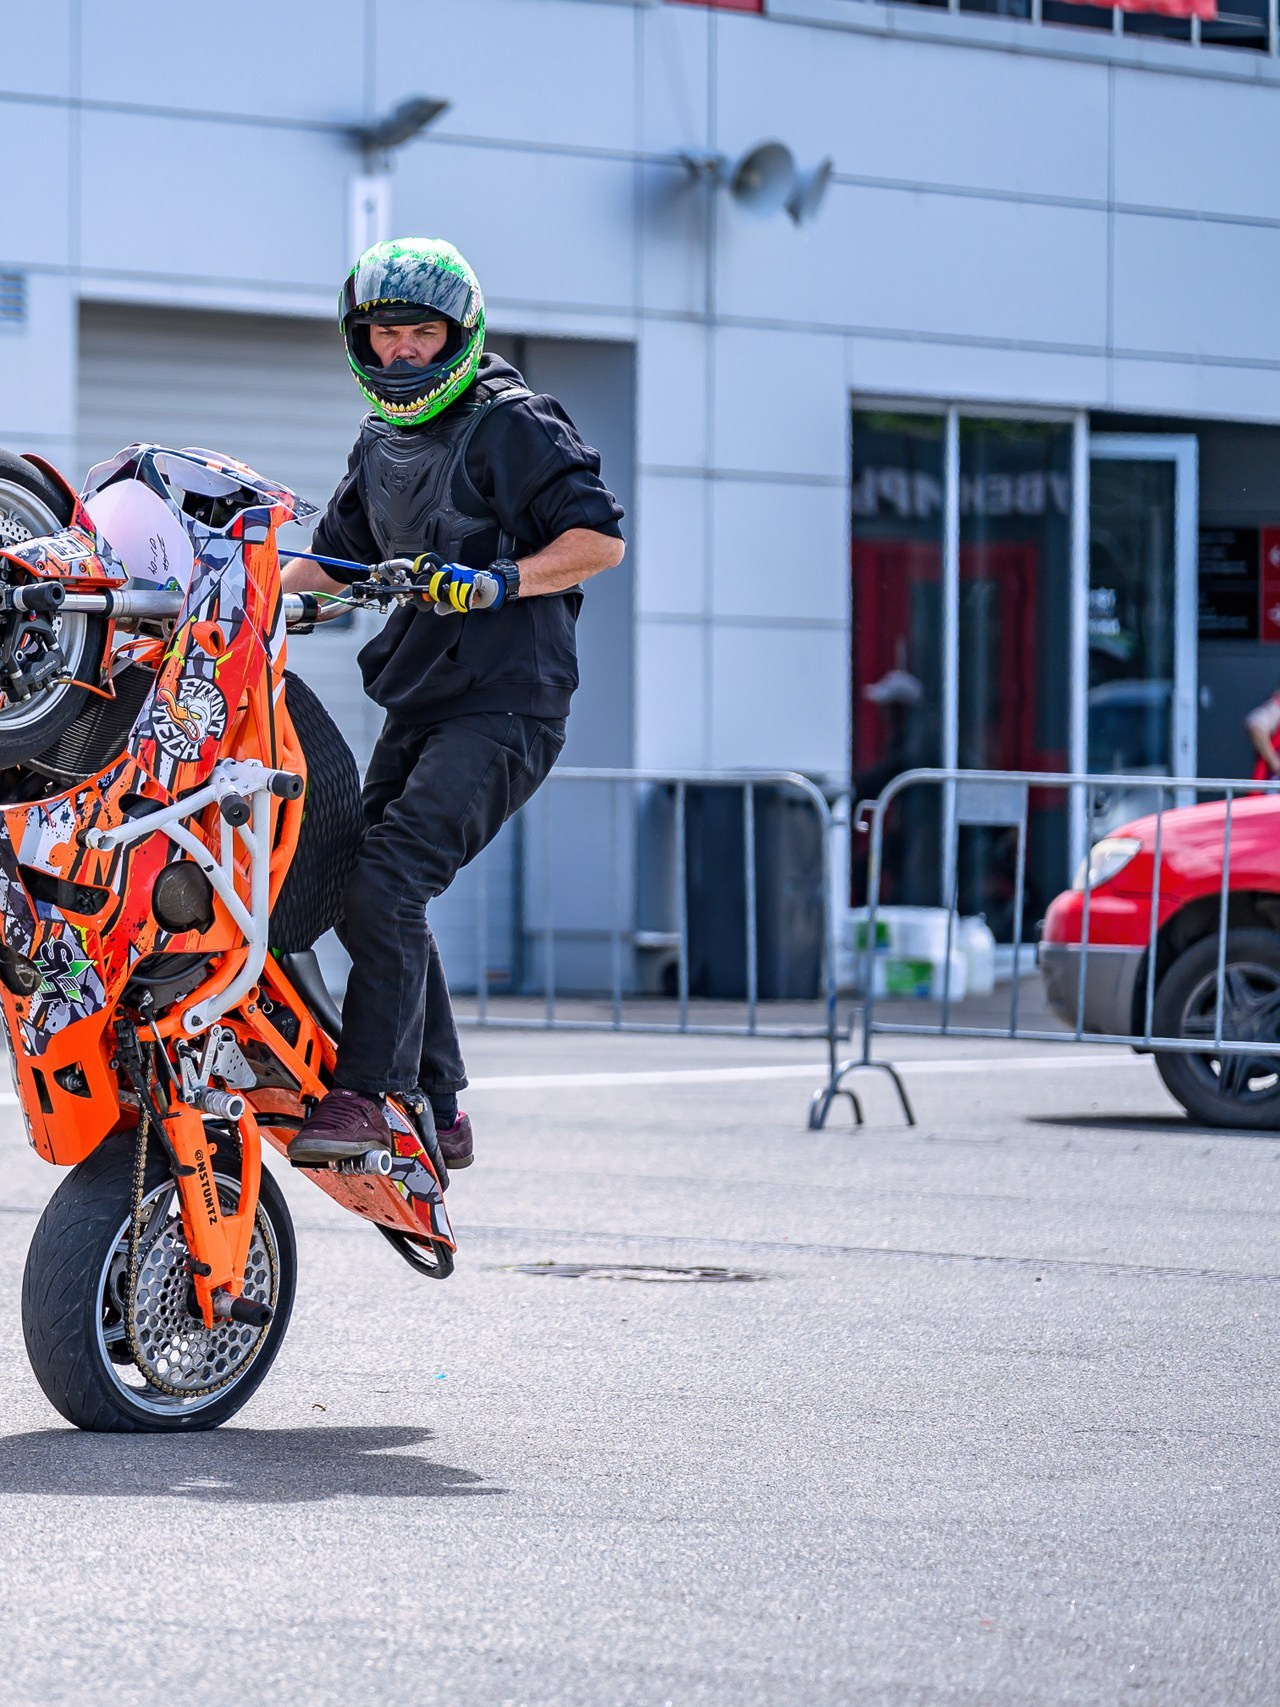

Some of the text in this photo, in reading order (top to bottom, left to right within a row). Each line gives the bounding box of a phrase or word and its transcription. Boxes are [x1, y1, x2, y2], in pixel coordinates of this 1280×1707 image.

[35, 659, 57, 676] TOKICO
[151, 703, 201, 760] TECH
[178, 677, 227, 739] STUNT
[194, 1149, 218, 1226] @NSTUNTZ
